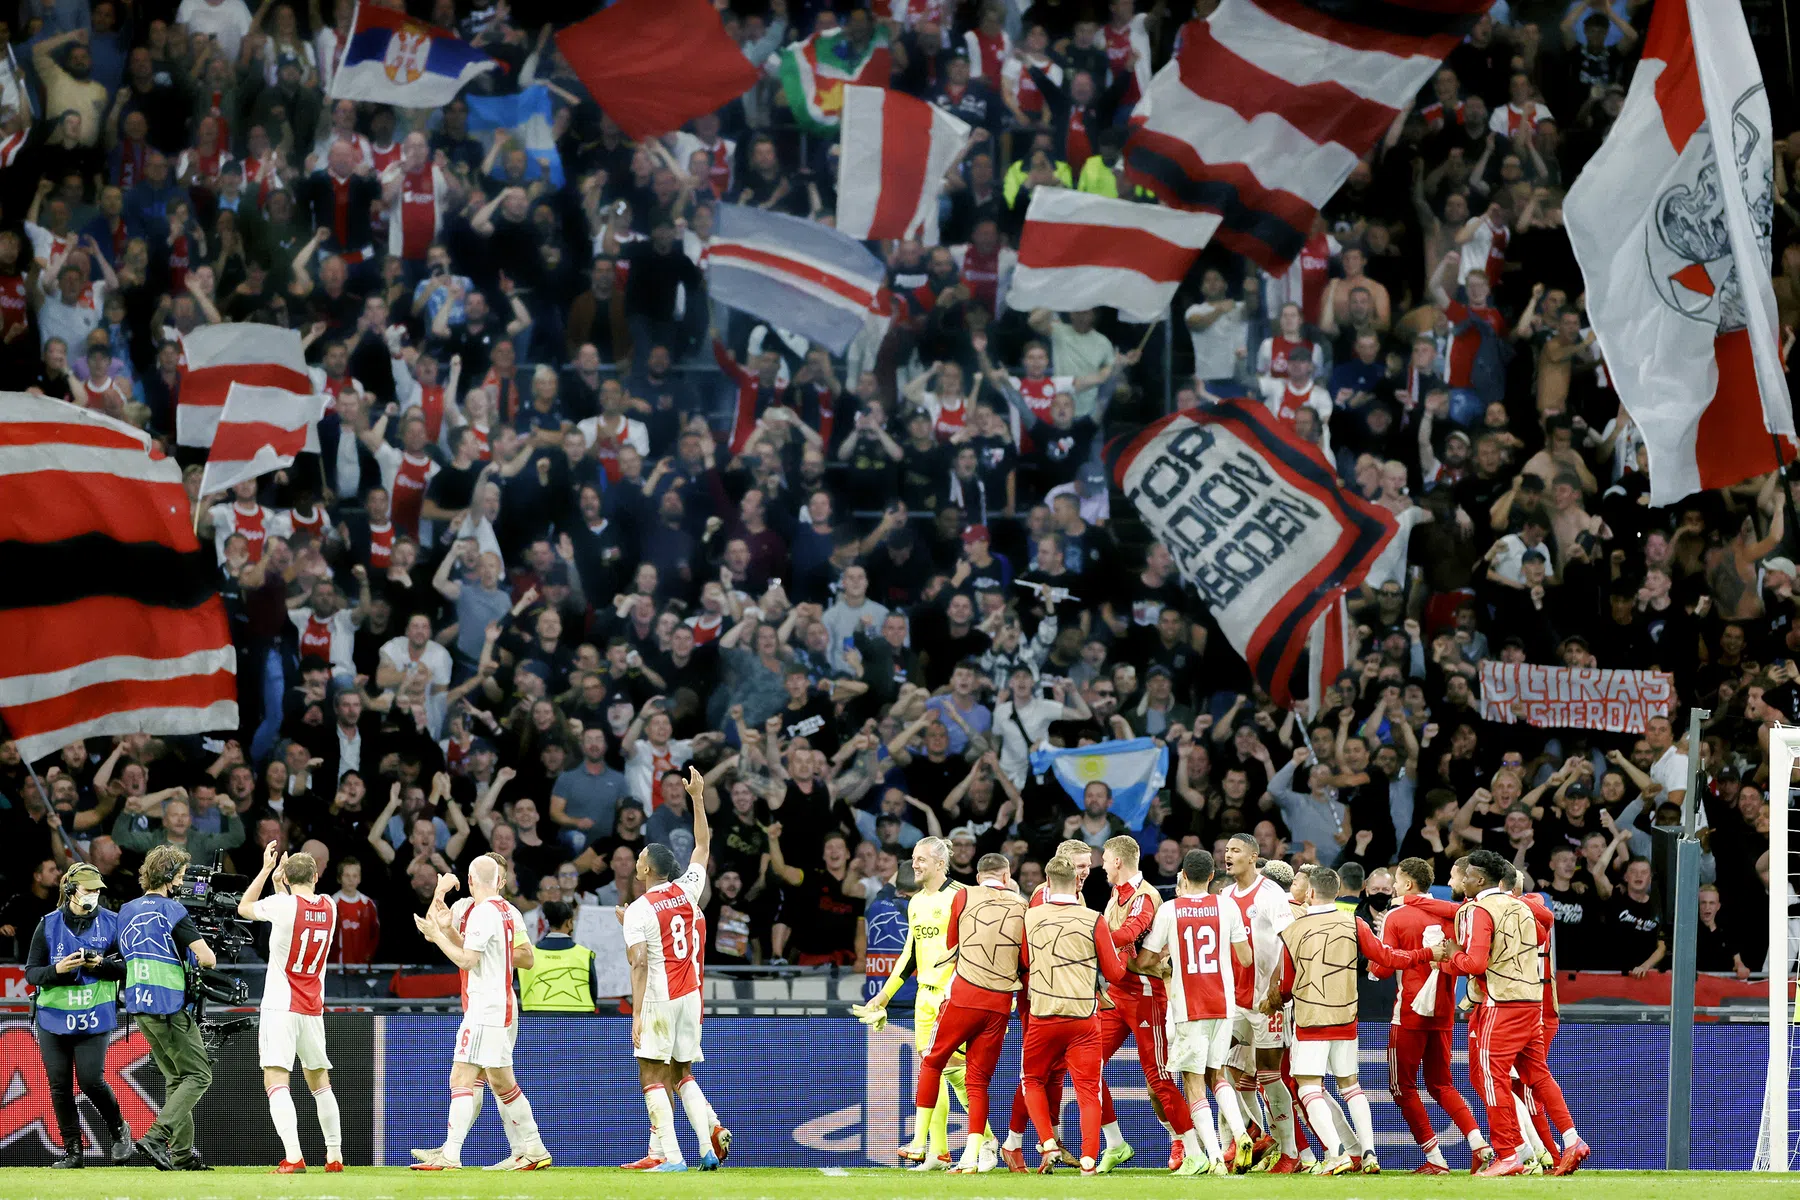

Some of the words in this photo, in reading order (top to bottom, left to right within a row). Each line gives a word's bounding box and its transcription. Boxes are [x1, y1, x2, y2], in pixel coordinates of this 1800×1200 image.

[1480, 662, 1672, 701] ULTRAS
[304, 910, 327, 922] BLIND
[1176, 906, 1218, 918] MAZRAOUI
[670, 914, 688, 960] 8
[291, 927, 328, 974] 17
[1183, 925, 1218, 974] 12
[68, 988, 93, 1006] HB
[66, 1010, 99, 1031] 033
[1268, 1012, 1283, 1032] 22
[461, 1028, 470, 1047] 6
